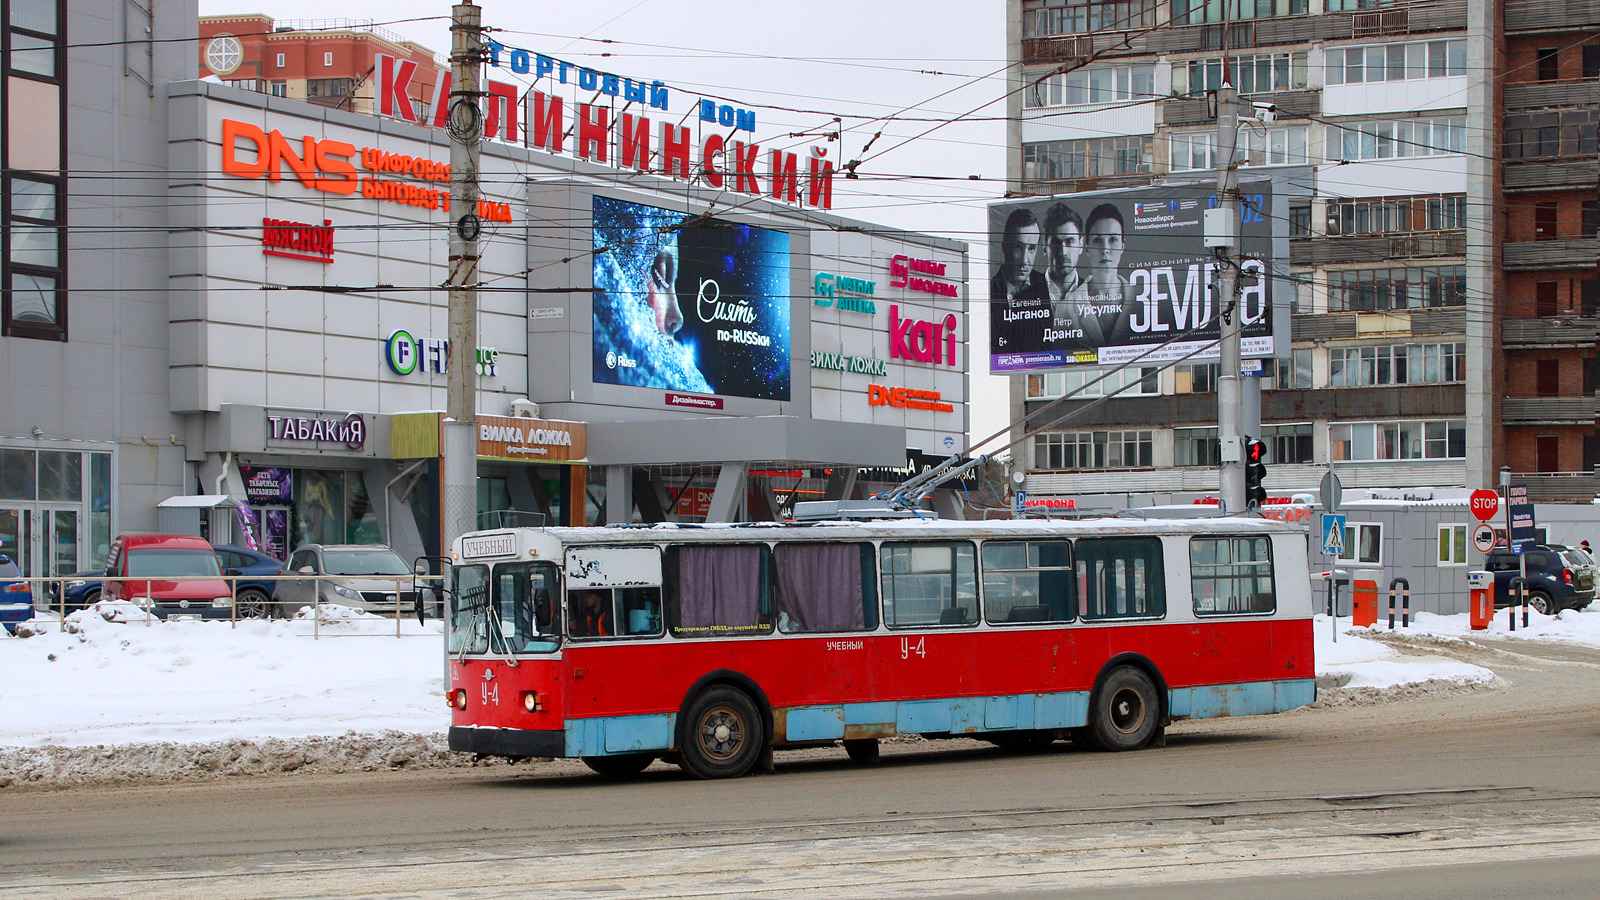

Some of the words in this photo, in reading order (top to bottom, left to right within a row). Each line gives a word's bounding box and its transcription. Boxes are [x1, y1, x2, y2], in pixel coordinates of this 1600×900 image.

[487, 41, 668, 111] ТОРГОВЫЙ
[699, 99, 756, 132] ДОМ
[222, 119, 358, 195] DNS
[362, 177, 439, 210] БЫТОВАЯ
[1135, 214, 1174, 224] Новосибирск
[263, 218, 334, 255] МЯСНОЙ
[1129, 258, 1190, 268] СИМФОНИЯ
[836, 276, 876, 295] МАГНИТ
[697, 276, 757, 323] Сиять
[836, 297, 876, 315] АПТЕКА
[1012, 297, 1041, 308] Евгений
[1077, 293, 1122, 302] Александра
[1003, 308, 1050, 322] Цыганов
[1077, 303, 1122, 317] Урсуляк
[1053, 317, 1072, 327] Пётр
[717, 329, 770, 347] по-RUSSки
[890, 304, 957, 366] kari
[998, 337, 1007, 346] 6+
[1043, 328, 1083, 342] Дранга
[810, 350, 845, 371] ВИЛКА
[848, 355, 887, 376] ЛОЖКА
[868, 384, 907, 408] DNS
[480, 424, 524, 443] ВИЛКА
[527, 428, 572, 446] ЛОЖКА
[247, 488, 280, 496] МАГАЗИНОВ
[1473, 498, 1497, 509] STOP
[466, 535, 513, 556] УЧЕБНЫЙ
[826, 640, 863, 651] УЧЕБНЫЙ
[901, 636, 926, 659] У-4
[481, 682, 499, 706] У-4
